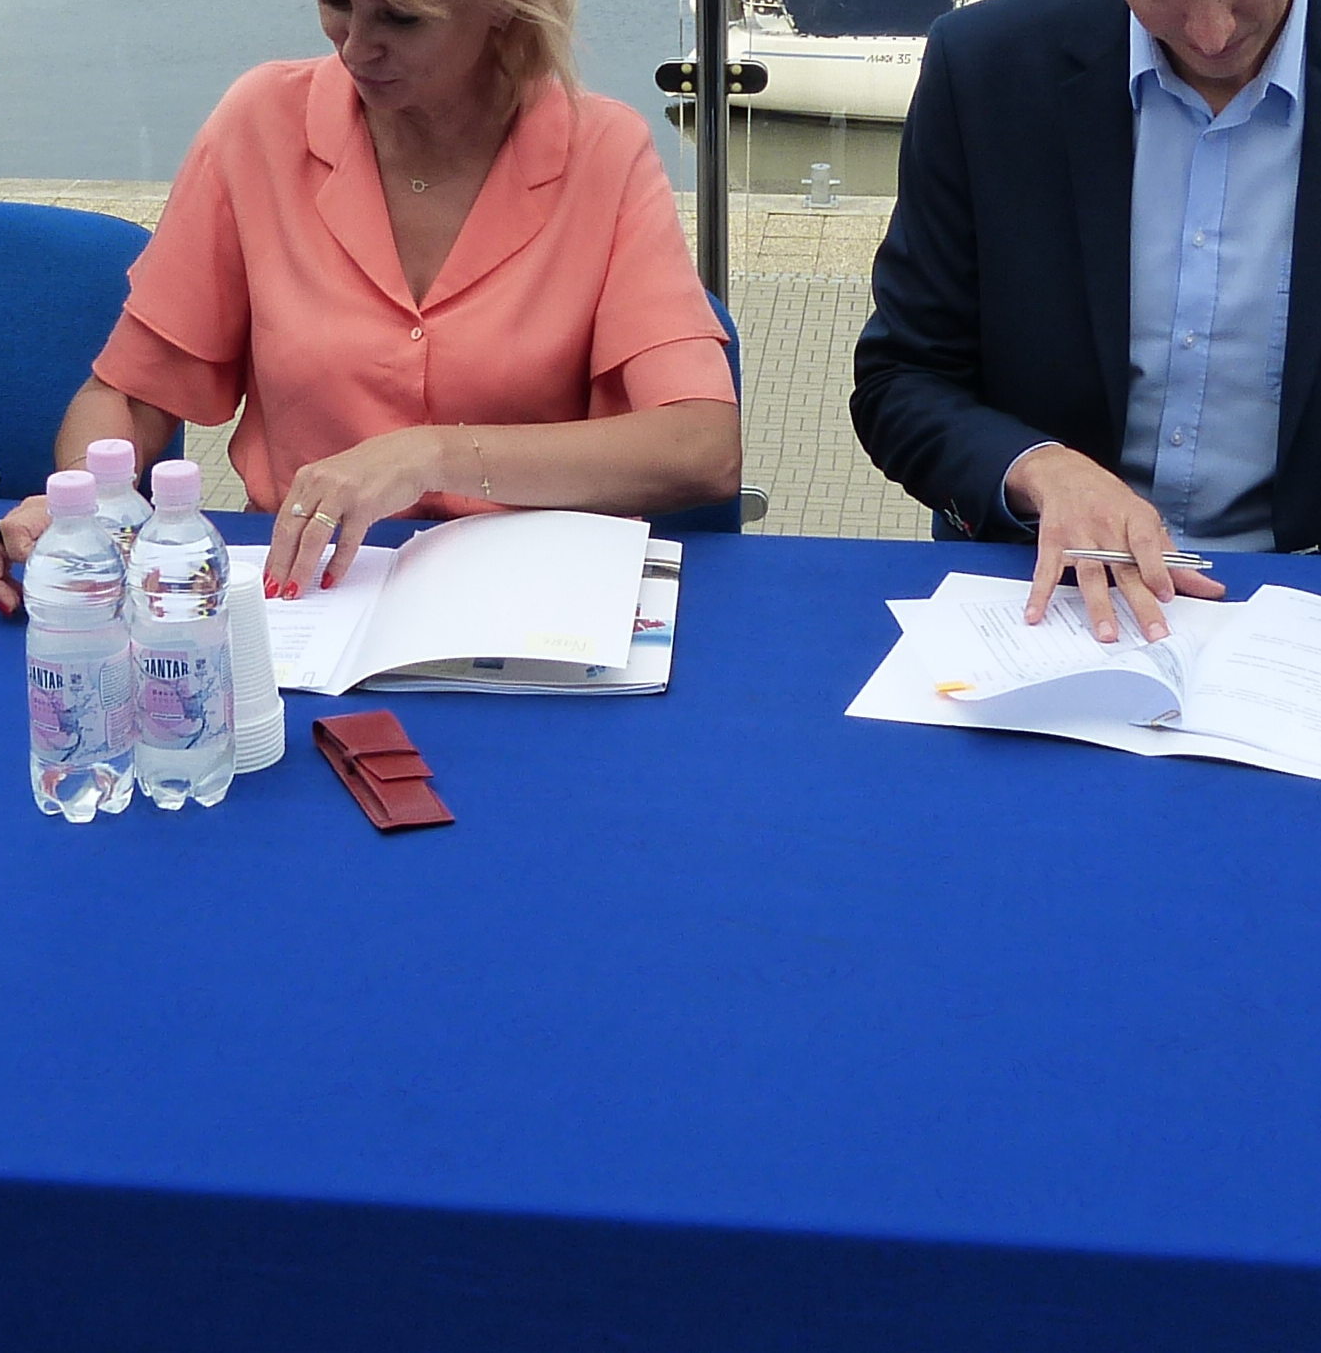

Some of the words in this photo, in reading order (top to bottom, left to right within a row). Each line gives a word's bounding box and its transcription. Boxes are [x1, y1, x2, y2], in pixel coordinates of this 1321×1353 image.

[897, 53, 911, 65] 35
[30, 665, 63, 689] ANTAR
[143, 658, 189, 678] JANTAR
